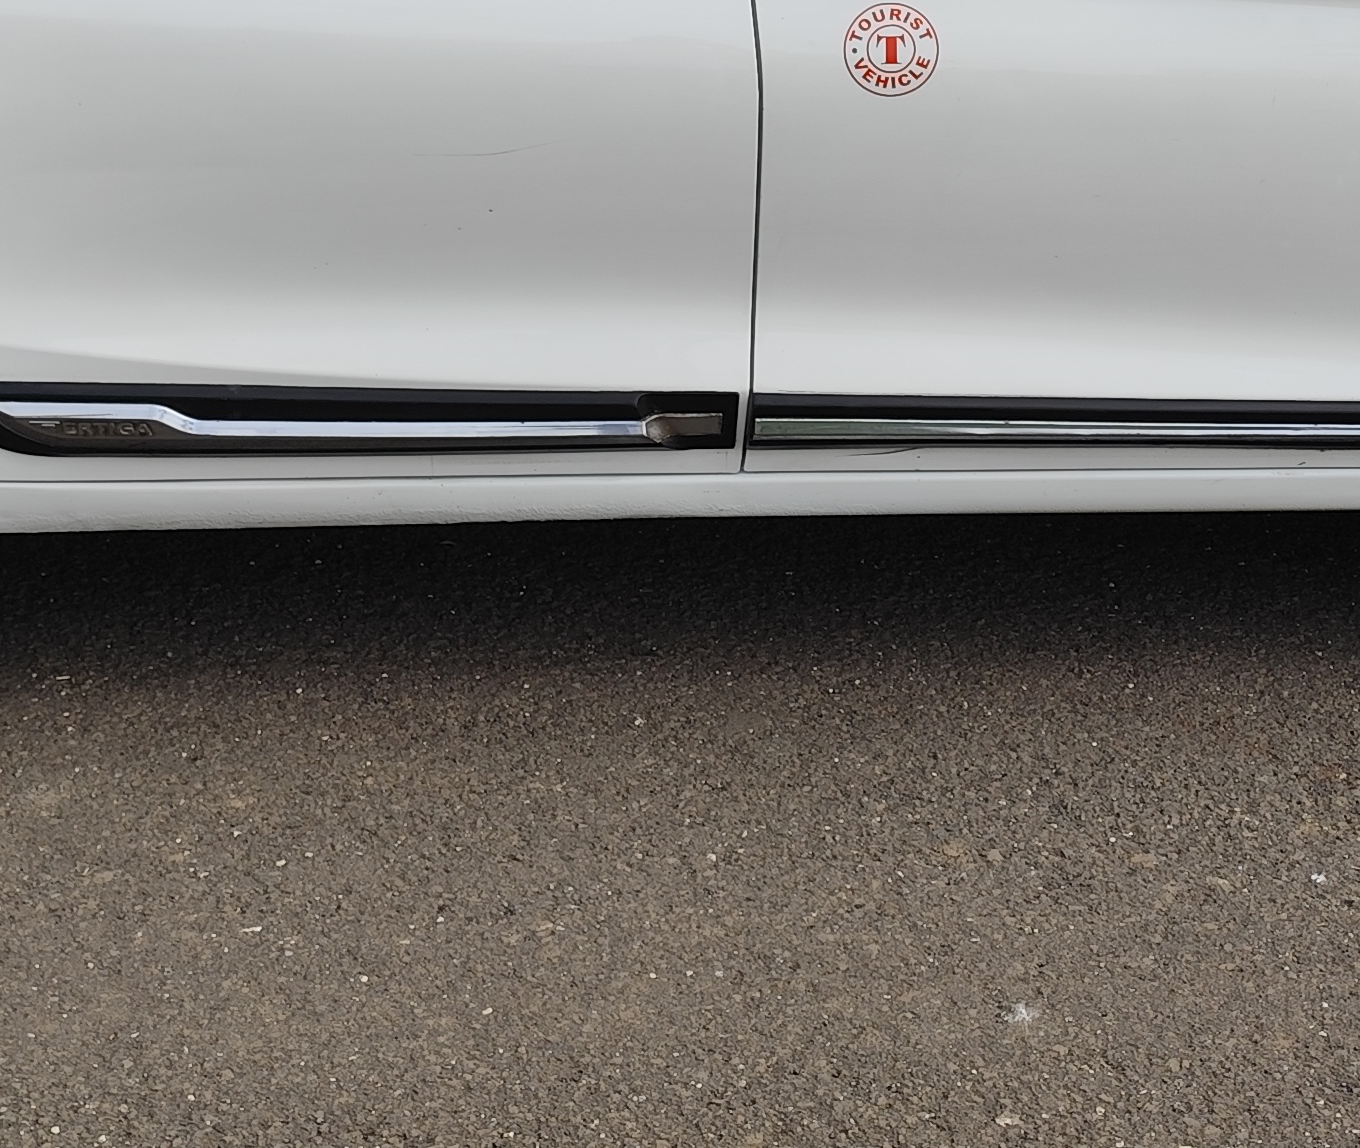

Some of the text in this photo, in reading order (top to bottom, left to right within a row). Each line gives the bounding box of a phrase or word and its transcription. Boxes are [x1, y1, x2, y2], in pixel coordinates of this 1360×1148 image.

[848, 8, 934, 42] TOURIST
[876, 33, 907, 65] T
[853, 55, 931, 90] VEHICLE
[61, 421, 154, 437] ERTIGA
